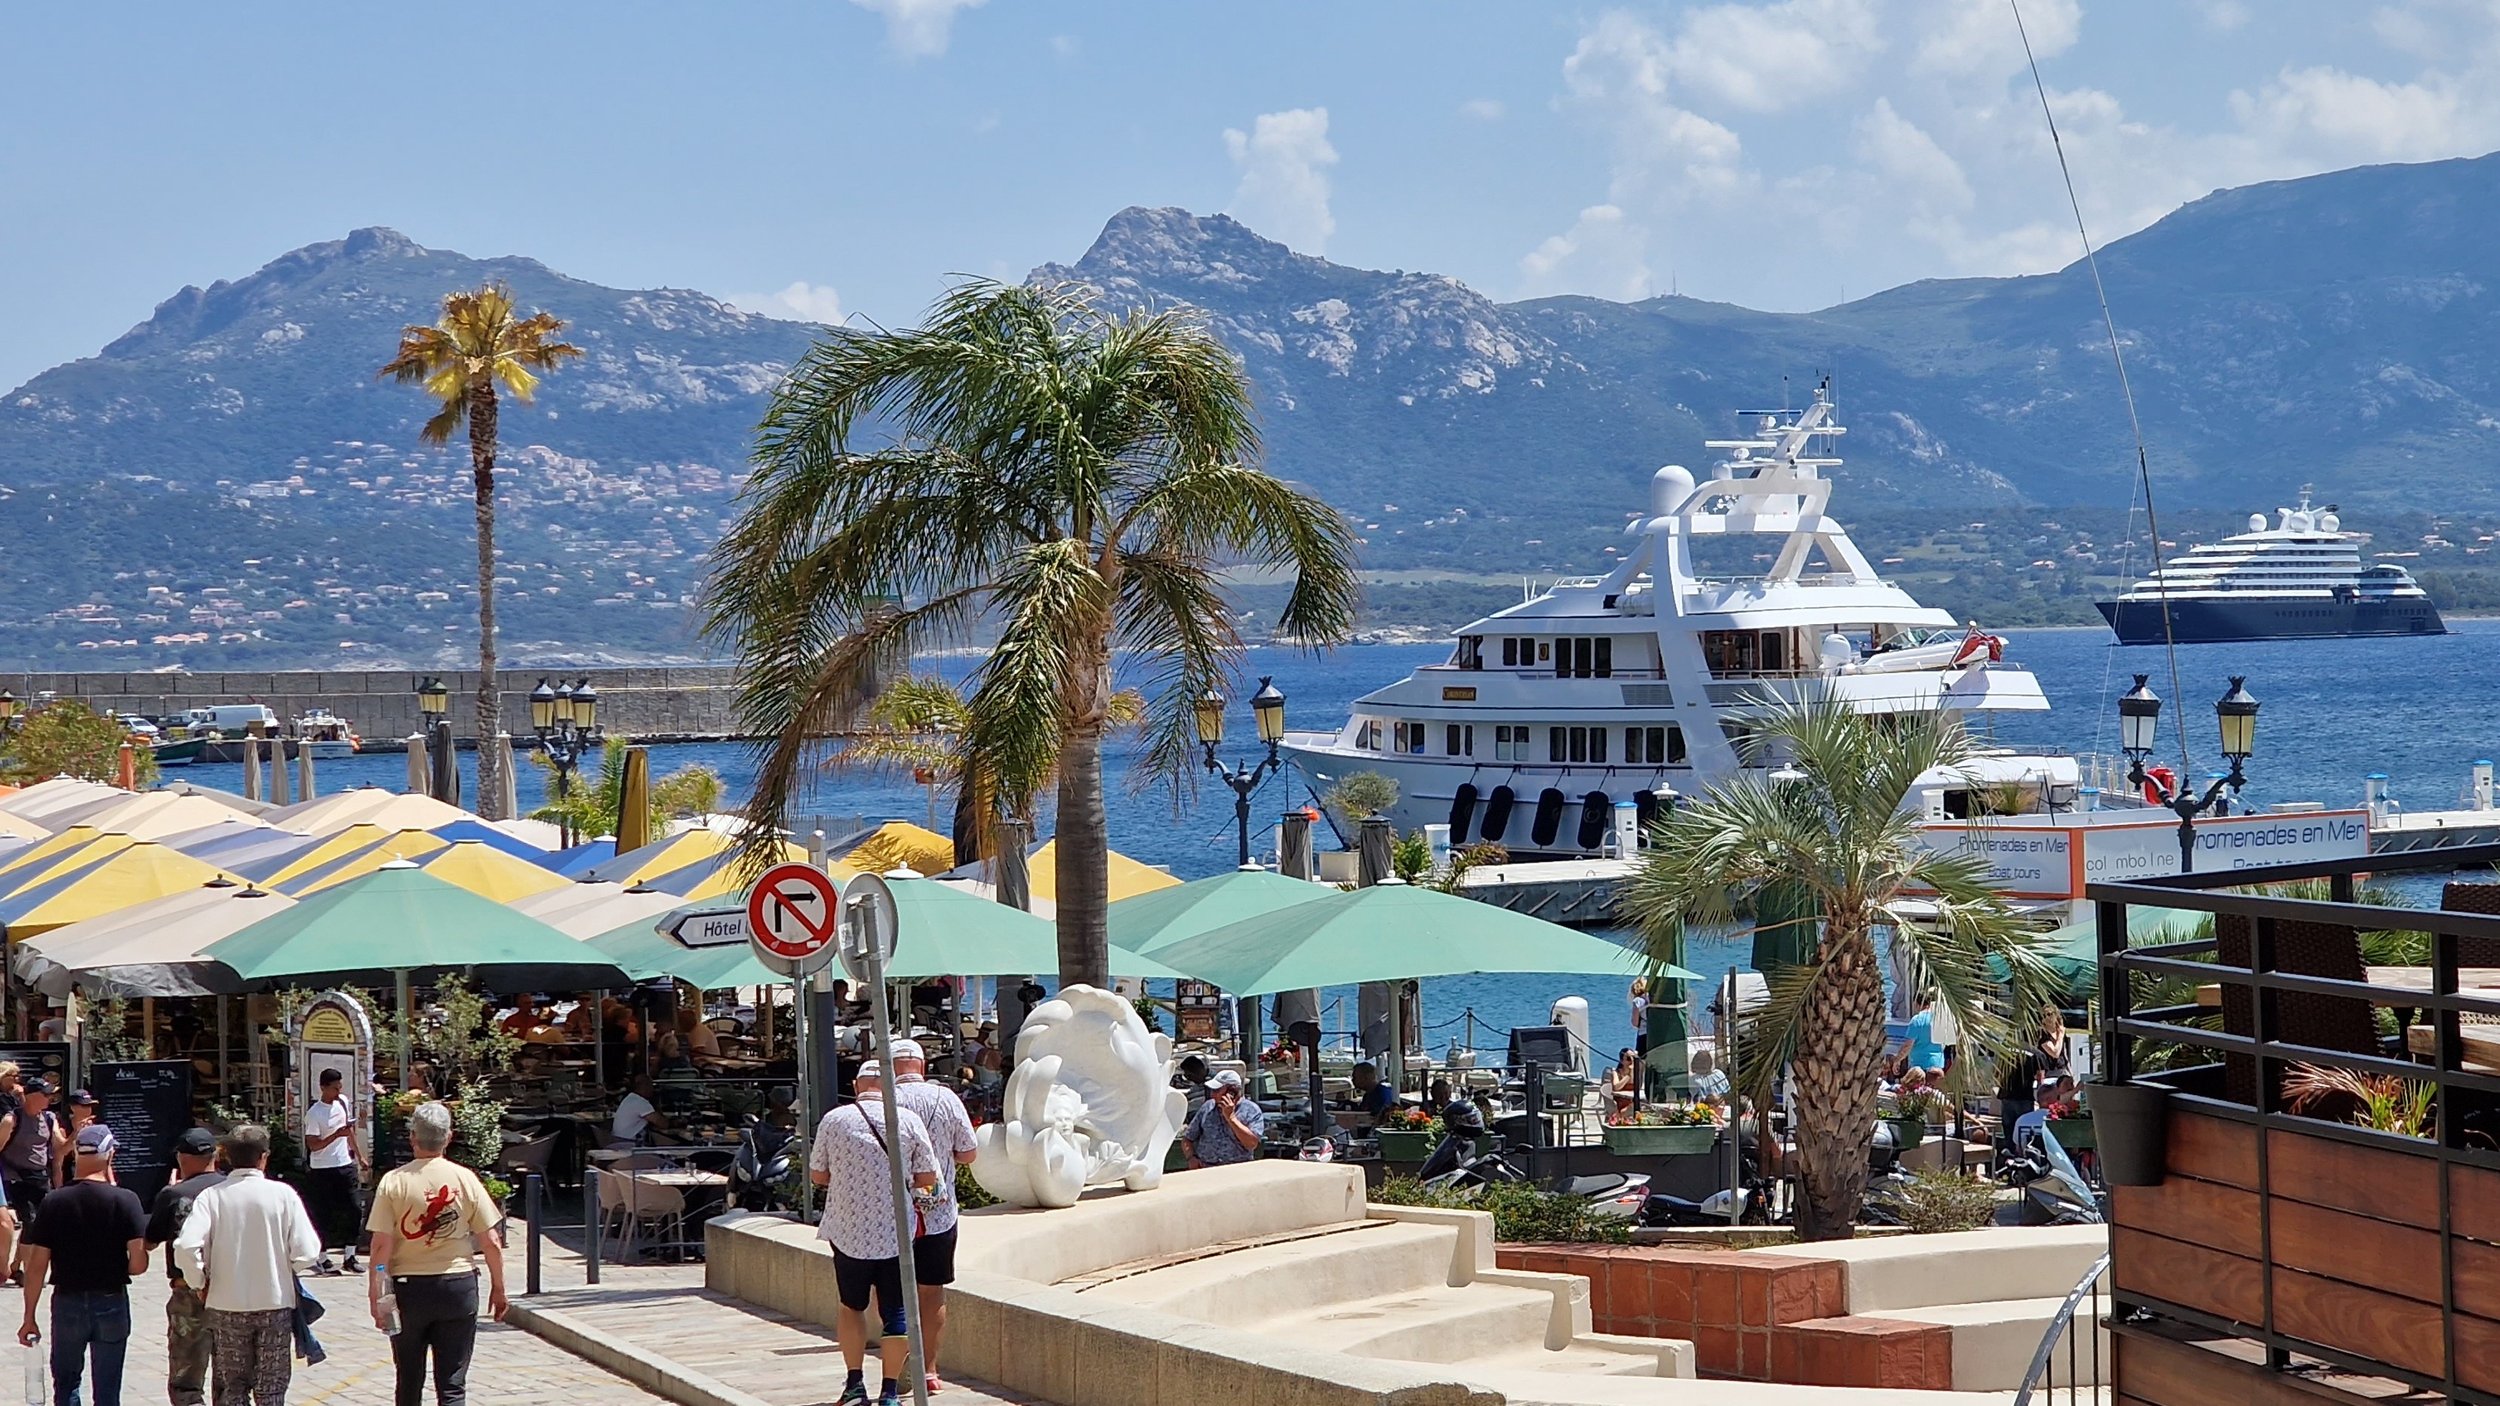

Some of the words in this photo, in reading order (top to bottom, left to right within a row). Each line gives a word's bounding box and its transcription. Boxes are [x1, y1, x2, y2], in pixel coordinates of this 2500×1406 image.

[1958, 836, 2027, 853] Promenades
[2029, 841, 2043, 853] en
[2045, 838, 2069, 853] Mer
[2196, 824, 2297, 850] romenades
[2302, 826, 2323, 843] en
[2327, 820, 2366, 841] Mer
[2085, 853, 2147, 872] colmbo
[2014, 867, 2041, 879] tours
[704, 919, 742, 938] Hôtel
